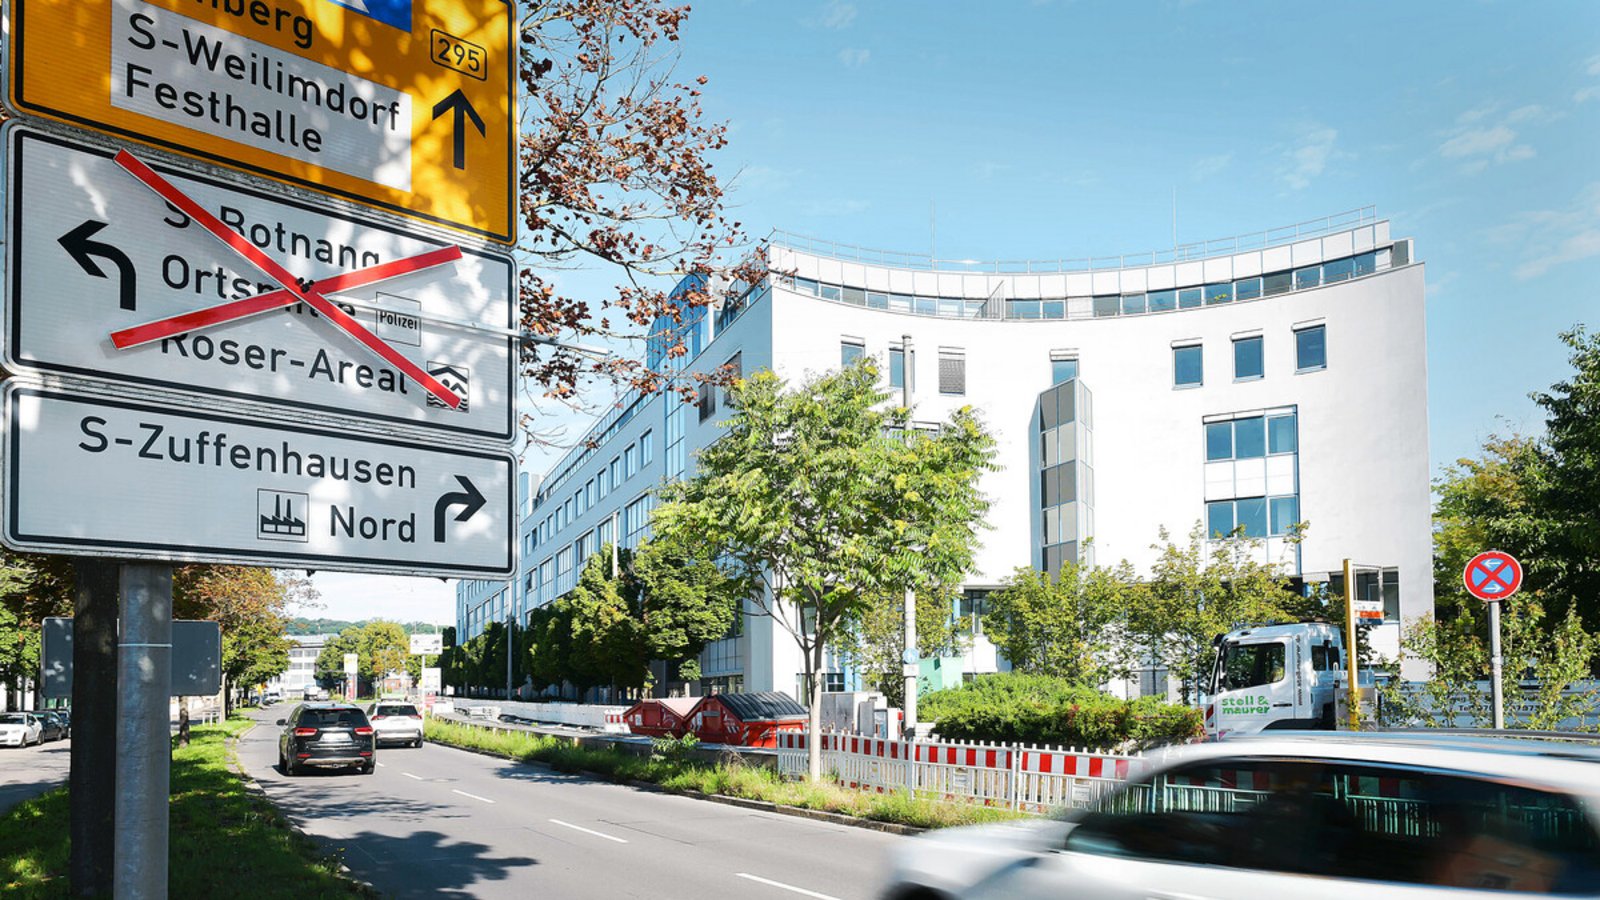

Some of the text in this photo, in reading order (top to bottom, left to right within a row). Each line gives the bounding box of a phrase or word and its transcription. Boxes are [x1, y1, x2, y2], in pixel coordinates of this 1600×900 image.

[196, 0, 313, 49] berg
[128, 13, 400, 131] S-Weilimdorf
[438, 39, 481, 72] 295
[126, 63, 322, 154] Festhalle
[379, 310, 417, 330] Polizei
[79, 415, 416, 488] S-Zuffenhausen
[330, 505, 416, 543] Nord
[1221, 695, 1269, 706] stoll &
[1222, 706, 1270, 715] maurer
